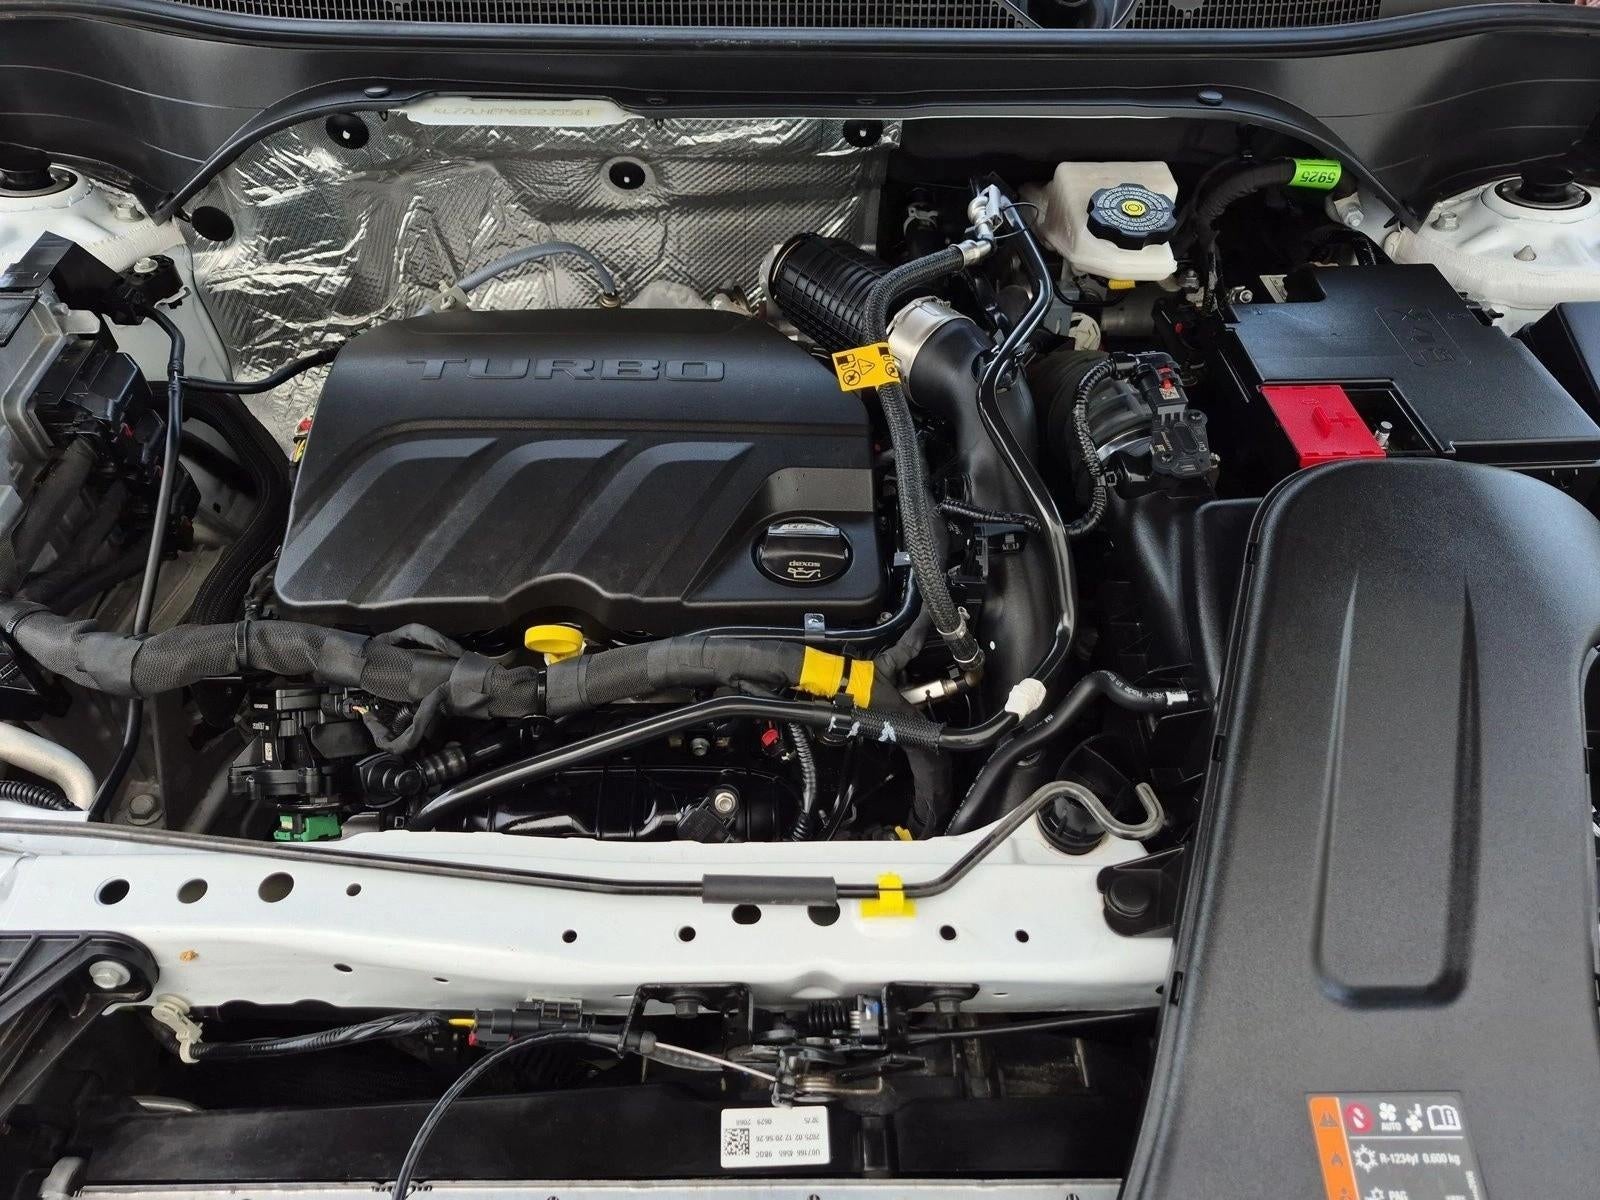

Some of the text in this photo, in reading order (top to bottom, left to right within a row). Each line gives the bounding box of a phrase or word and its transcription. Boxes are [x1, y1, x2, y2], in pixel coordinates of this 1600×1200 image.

[1300, 170, 1336, 183] 5925
[406, 358, 725, 382] TURBO
[1381, 1122, 1402, 1132] AUTO
[1447, 1153, 1461, 1167] kg
